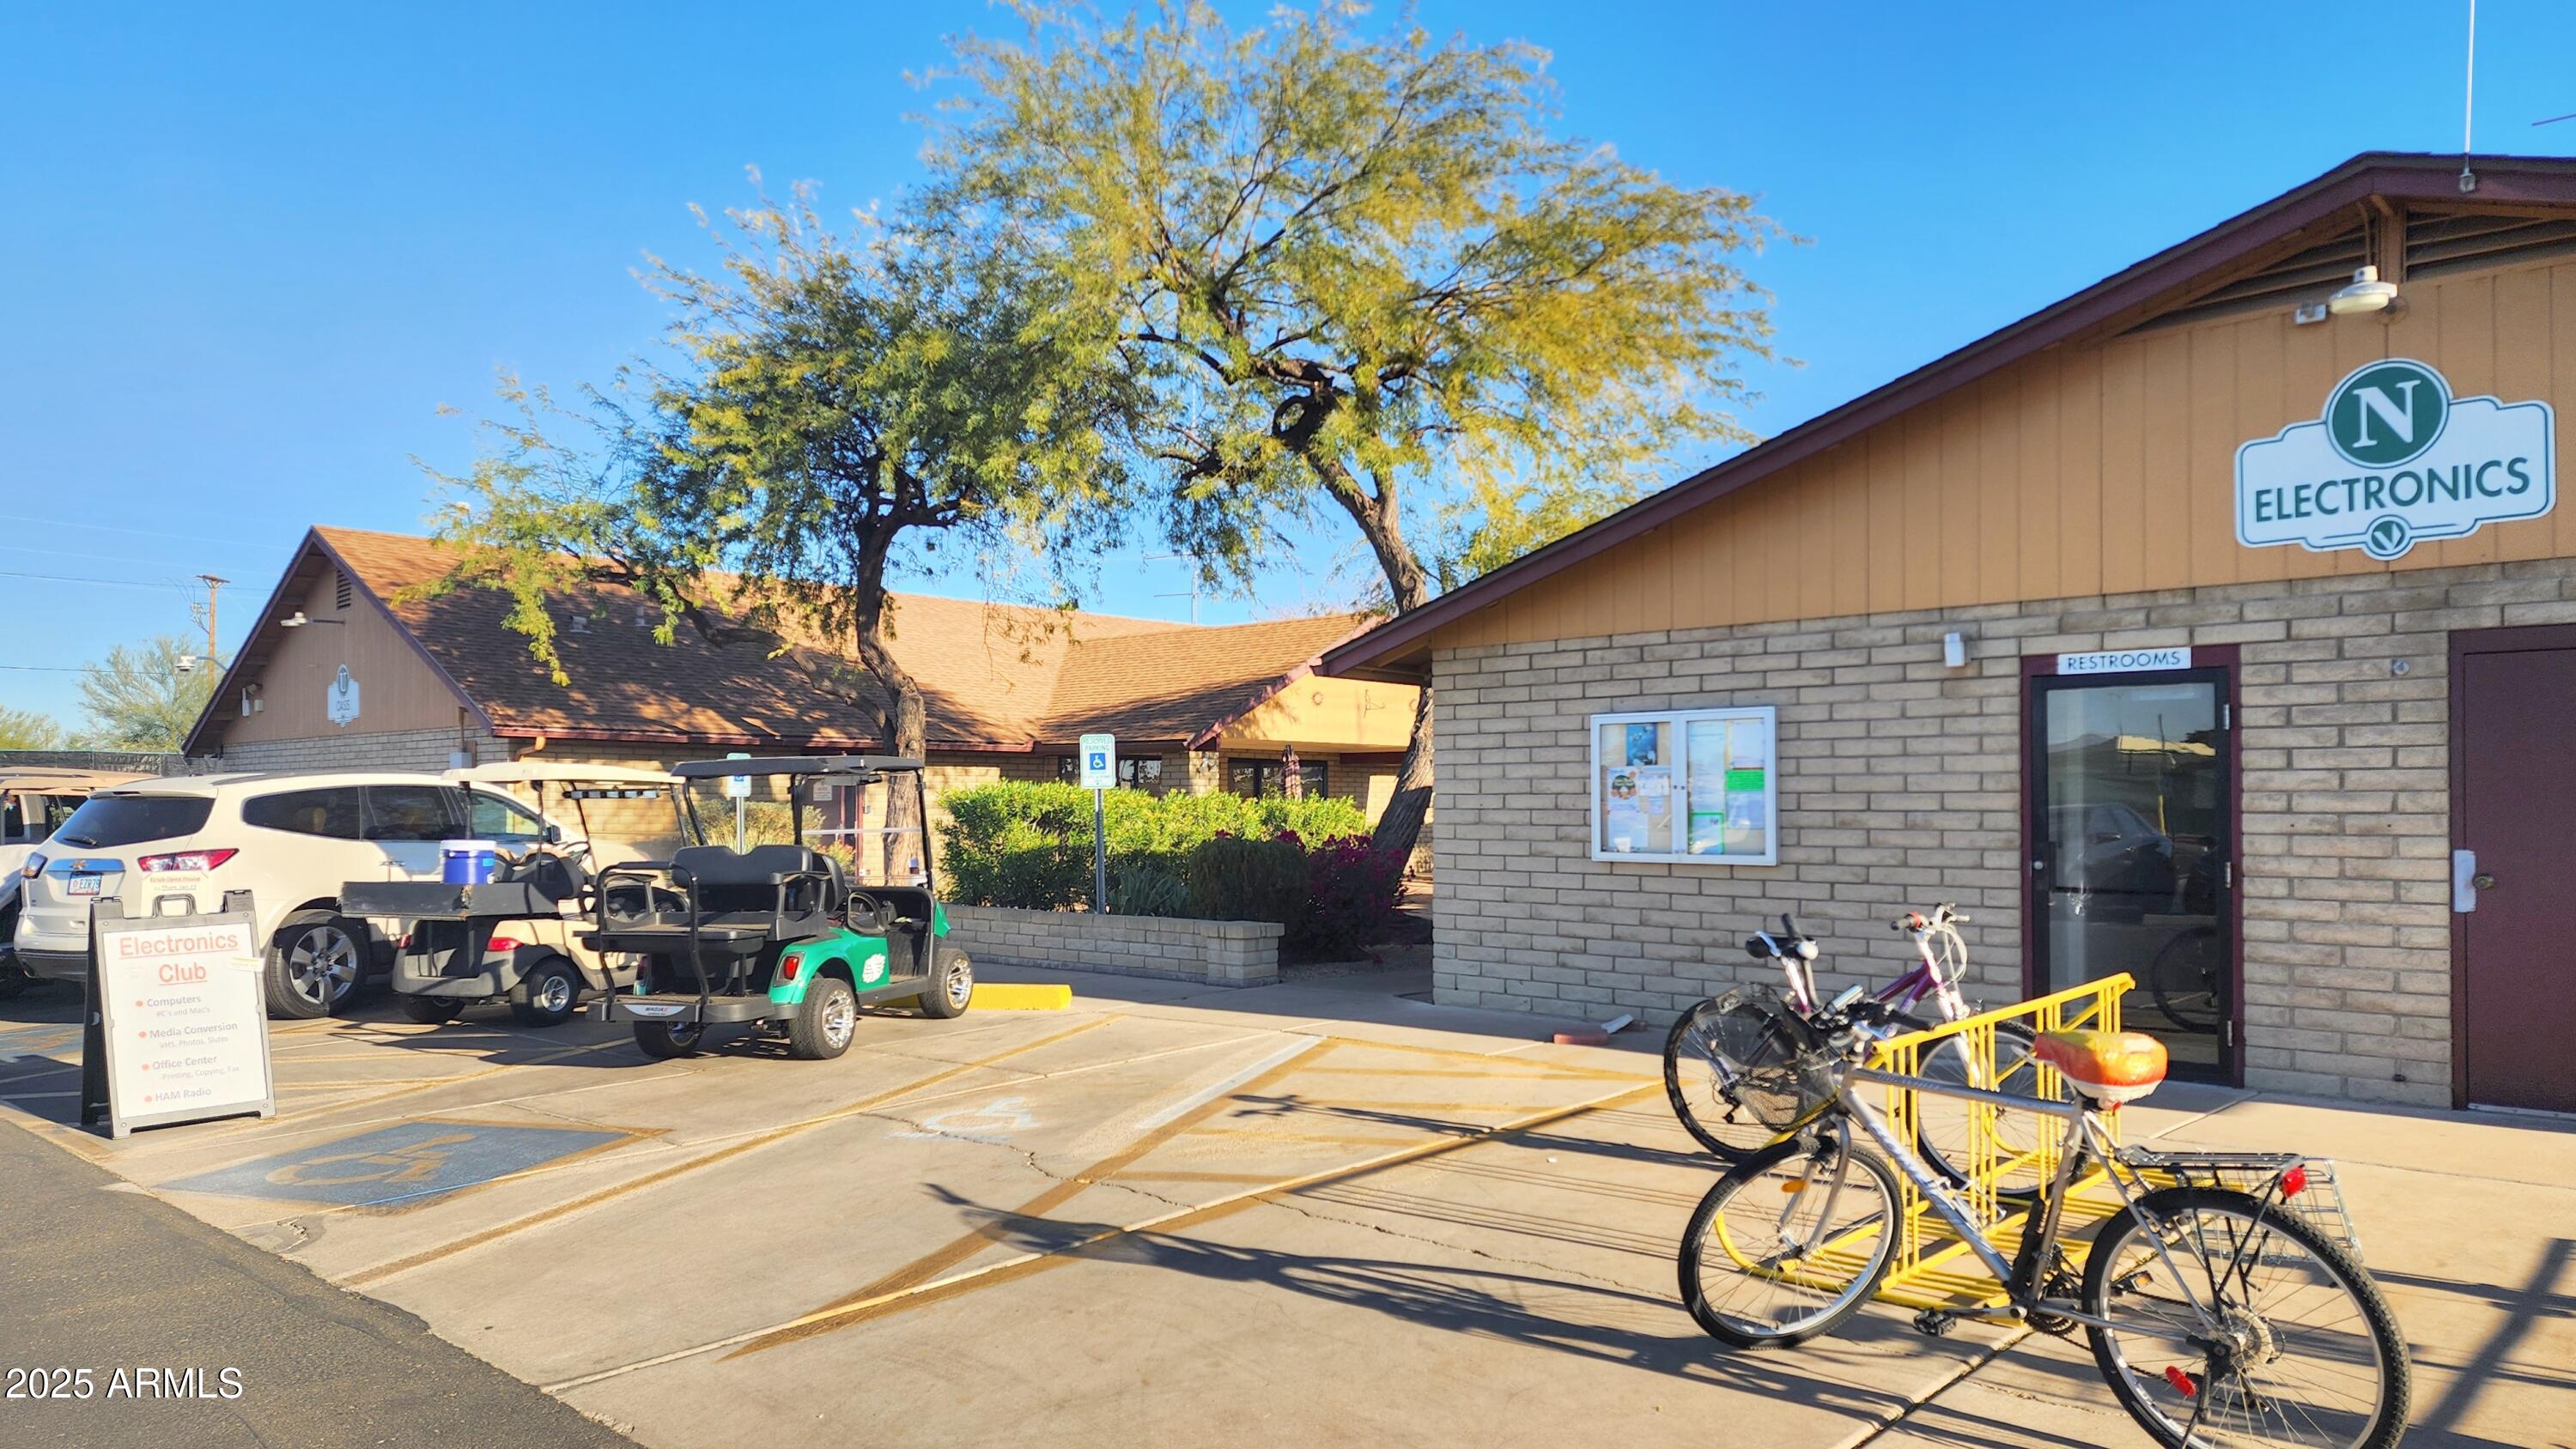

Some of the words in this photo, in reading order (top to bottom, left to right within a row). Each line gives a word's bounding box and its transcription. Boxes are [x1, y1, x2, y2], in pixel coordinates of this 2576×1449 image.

[2351, 379, 2421, 449] N
[2255, 456, 2530, 524] ELECTRONICS
[2068, 651, 2181, 670] RESTROOMS
[119, 931, 238, 956] Electronics
[158, 961, 207, 983] Club
[147, 995, 201, 1008] Computers
[189, 1006, 210, 1015] Mac's
[149, 1028, 182, 1039] Media
[184, 1022, 238, 1035] Conversion
[152, 1059, 182, 1070] Office
[185, 1055, 218, 1066] Center
[155, 1091, 180, 1102] HAM
[183, 1087, 211, 1099] Radio
